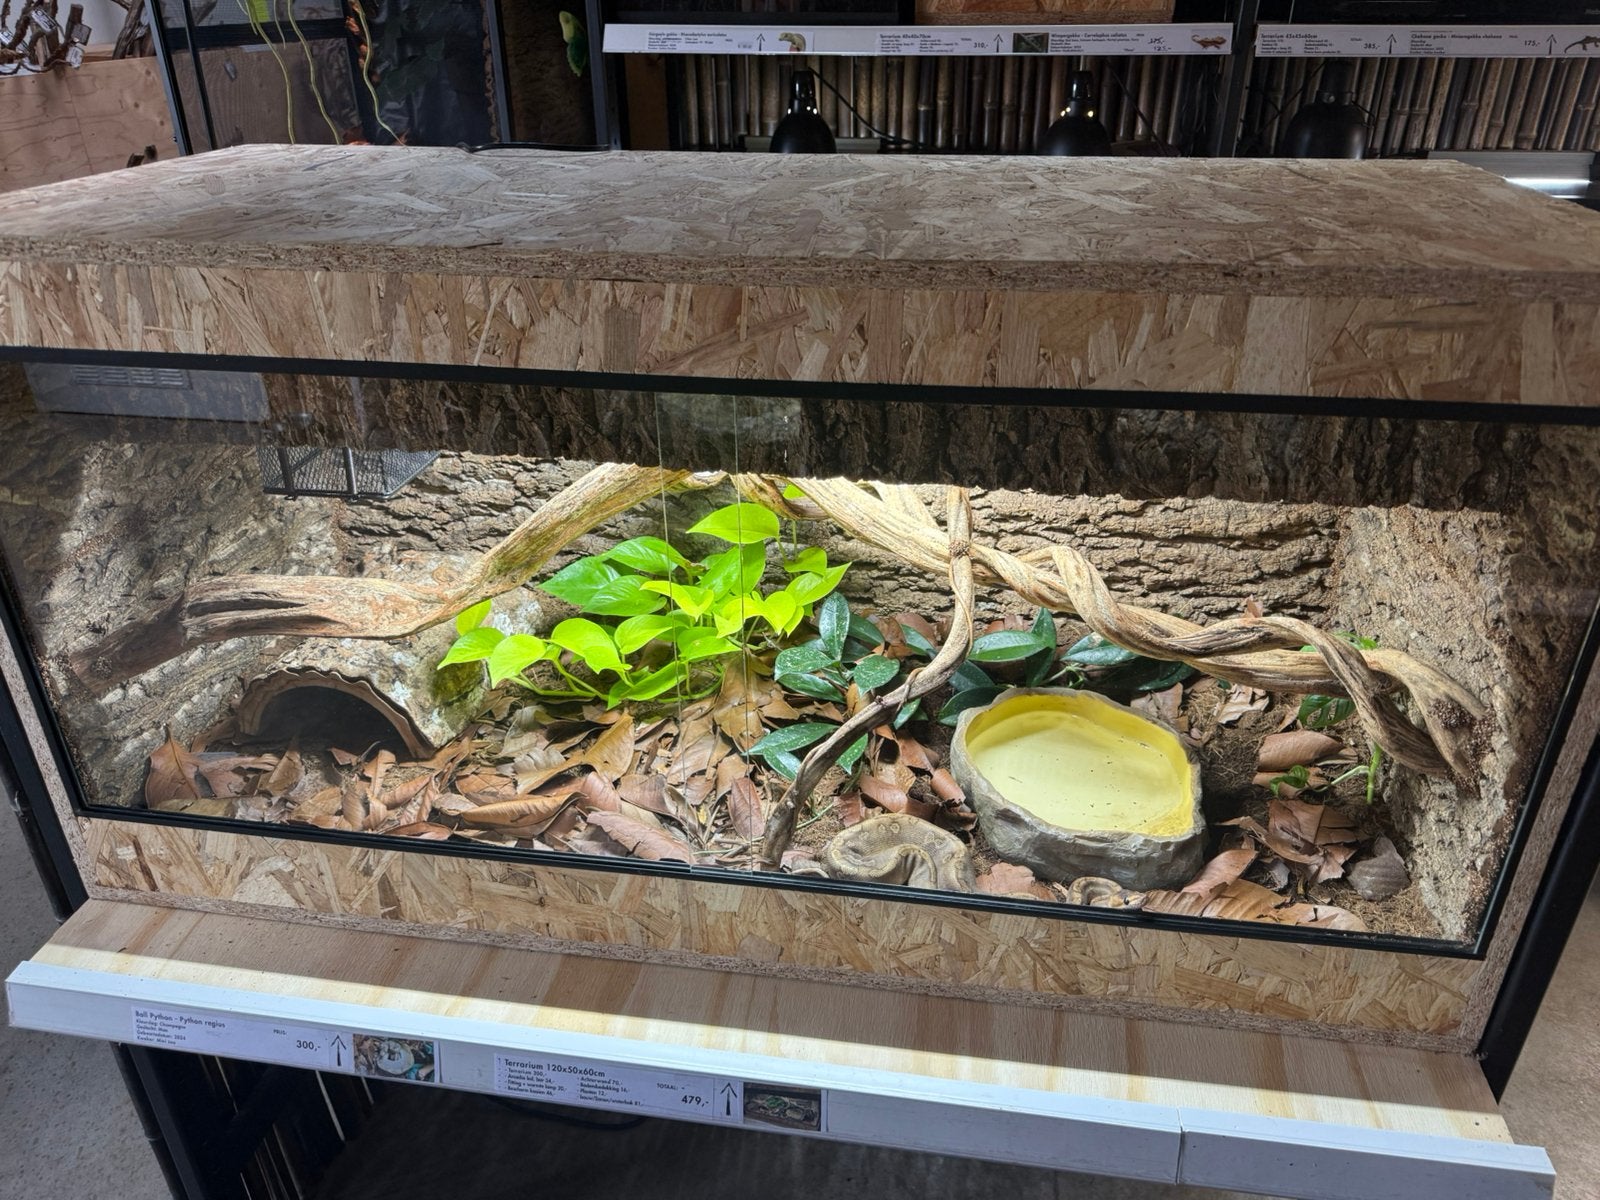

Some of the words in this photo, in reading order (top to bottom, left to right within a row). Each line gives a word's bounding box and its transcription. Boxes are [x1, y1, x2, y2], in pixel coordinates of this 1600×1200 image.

[135, 1010, 148, 1018] Ball
[150, 1012, 173, 1020] Python
[180, 1016, 203, 1025] Python
[205, 1020, 226, 1029] regius
[296, 1040, 321, 1052] 300,-
[505, 1058, 544, 1070] Terrarium
[547, 1063, 605, 1077] 120x50x60cm
[681, 1095, 709, 1108] 479,-
